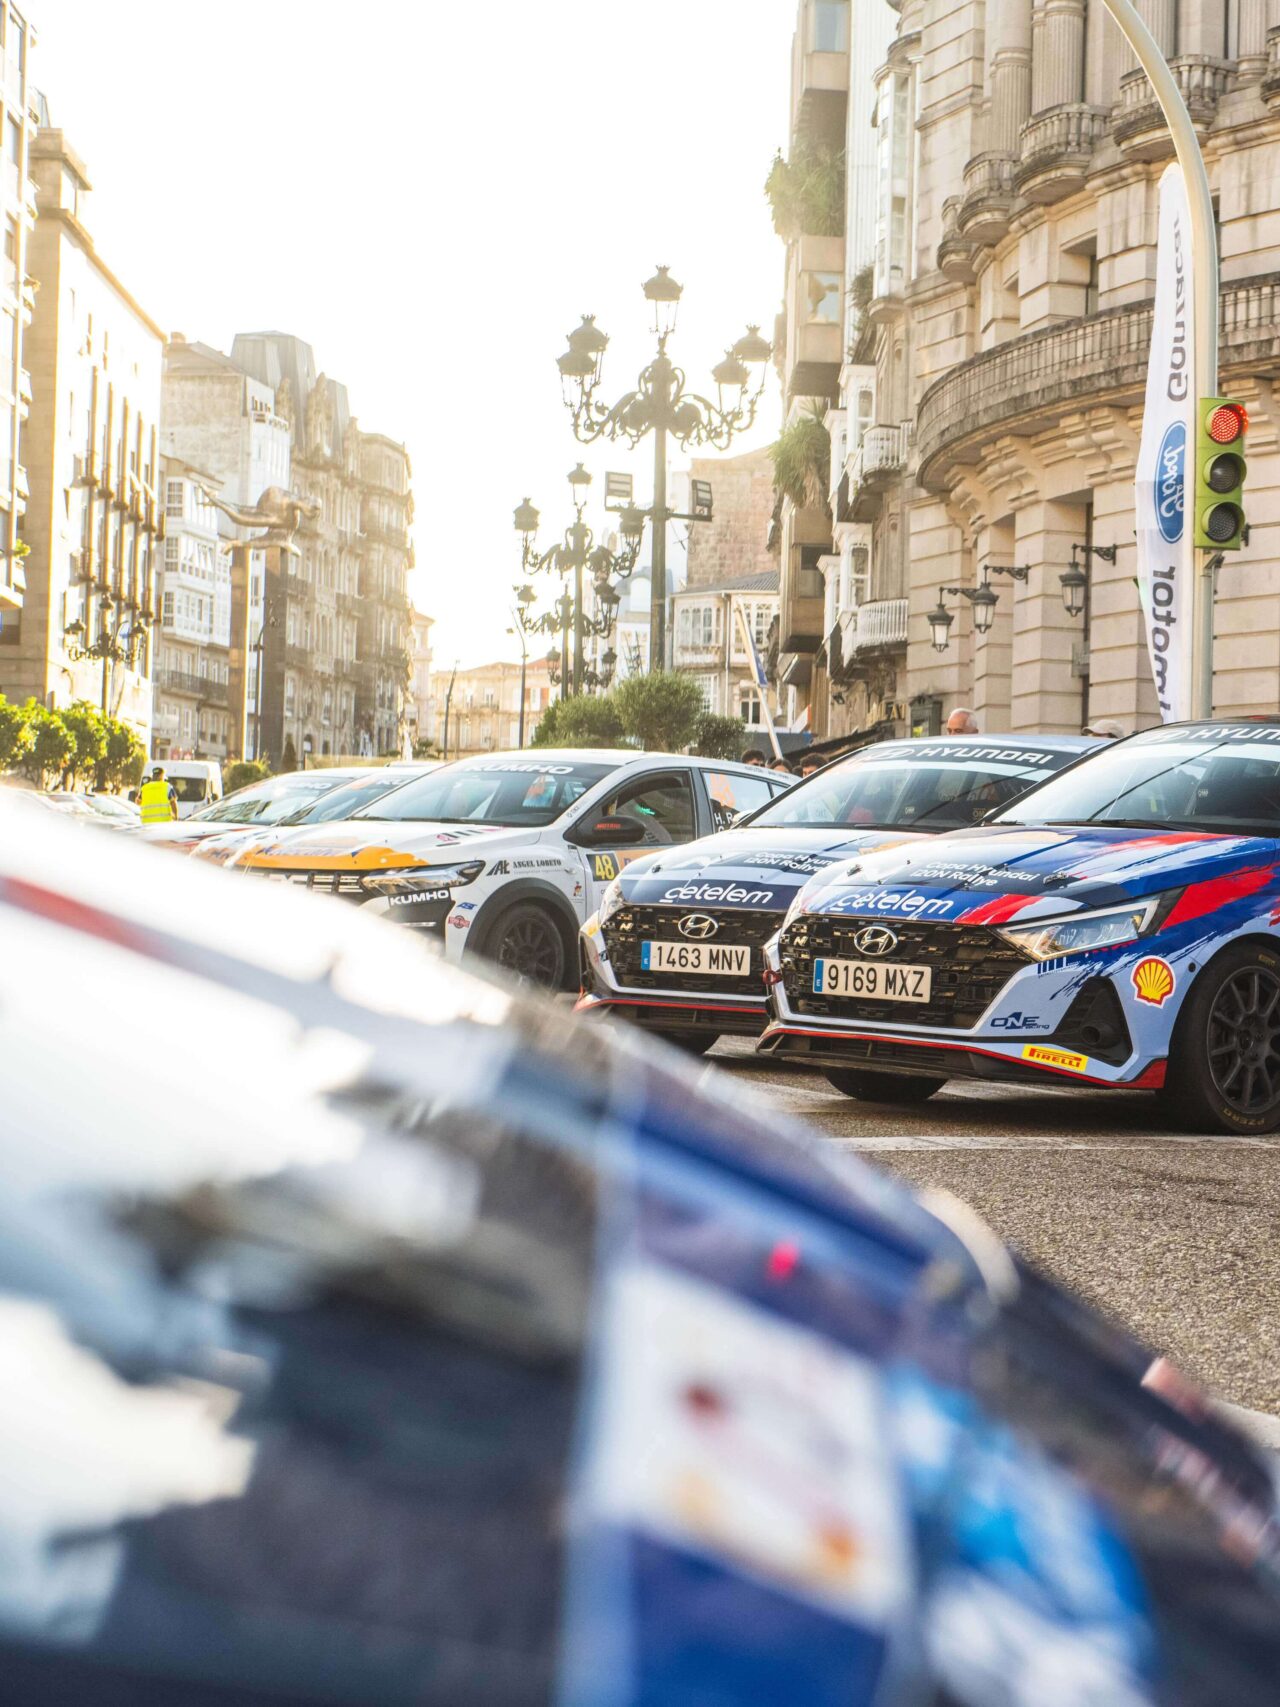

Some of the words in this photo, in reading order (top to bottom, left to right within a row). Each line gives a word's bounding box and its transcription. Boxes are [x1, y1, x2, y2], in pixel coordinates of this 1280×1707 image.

[916, 747, 1054, 764] HYUNDAI
[595, 854, 614, 880] 48
[926, 861, 972, 875] Copa
[972, 863, 1041, 883] Hyundai
[946, 870, 998, 887] Rallye
[389, 889, 450, 906] KUMHO
[660, 883, 774, 904] cetelem
[829, 890, 955, 916] cetelem
[656, 946, 702, 968] 1463
[709, 949, 745, 971] MNV
[828, 964, 877, 993] 9169
[885, 968, 925, 998] MXZ
[1028, 1048, 1082, 1068] PIRELLI
